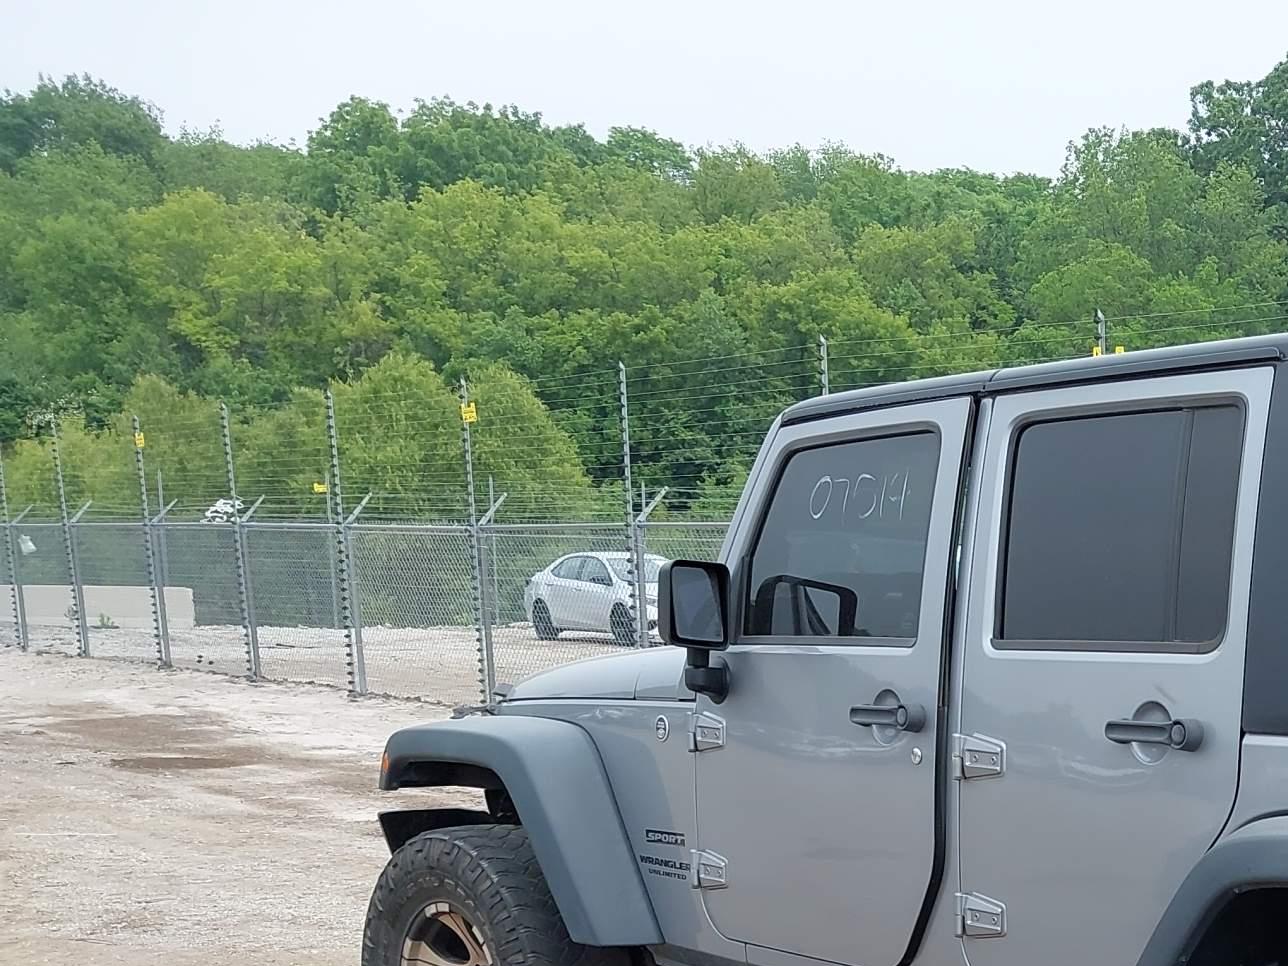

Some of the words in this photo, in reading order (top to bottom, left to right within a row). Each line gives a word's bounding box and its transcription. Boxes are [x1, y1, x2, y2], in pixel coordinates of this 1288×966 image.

[809, 471, 911, 520] 07514
[647, 832, 685, 844] SPORT
[640, 854, 691, 871] WRANGLER
[648, 868, 687, 880] UNLIMITED
